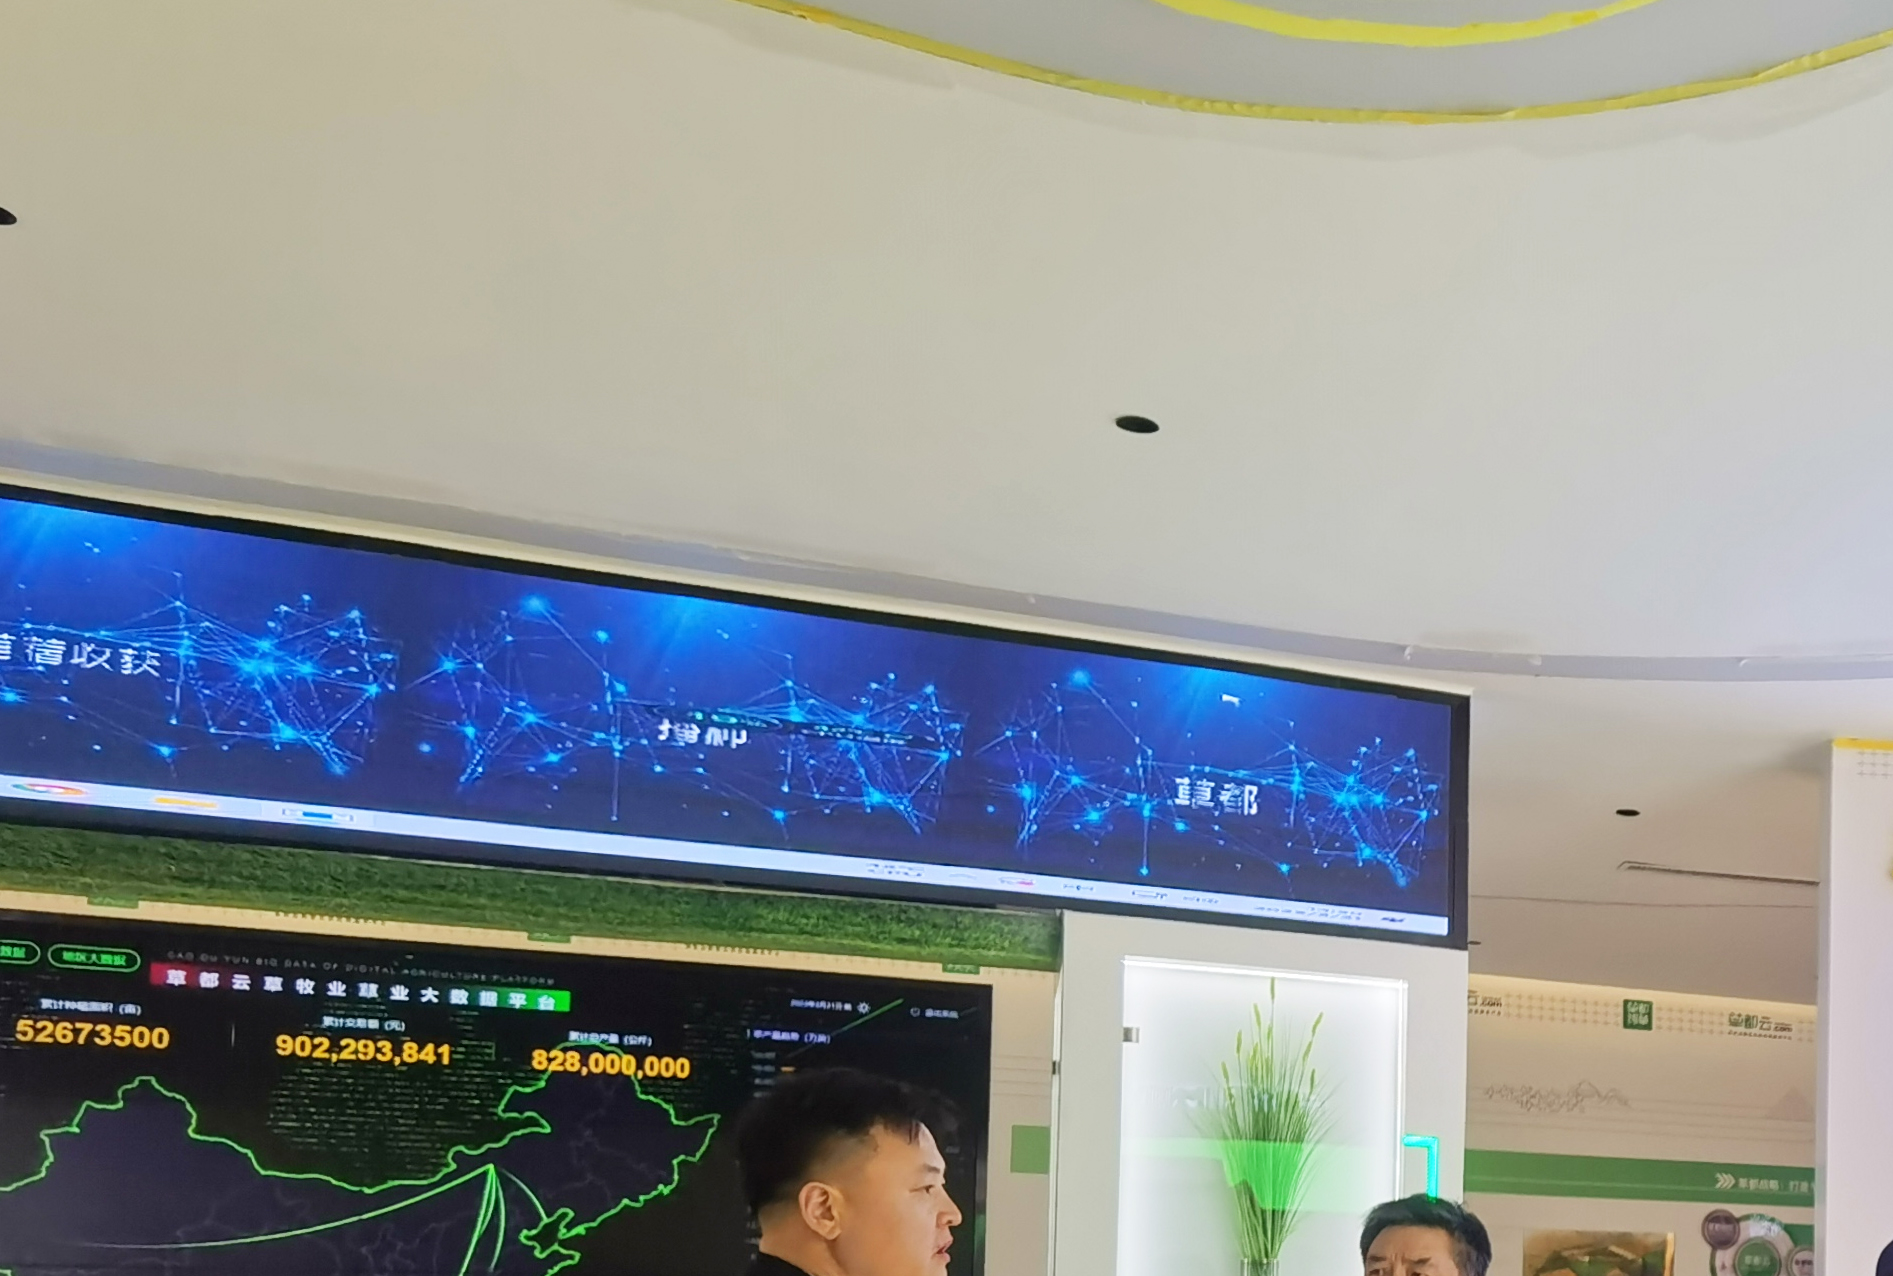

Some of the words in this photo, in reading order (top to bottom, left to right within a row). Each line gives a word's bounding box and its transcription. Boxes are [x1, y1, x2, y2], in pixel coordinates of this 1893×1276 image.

[15, 1018, 170, 1050] 52673500
[275, 1033, 450, 1067] 902,293,841
[531, 1049, 691, 1079] 828,000,000
